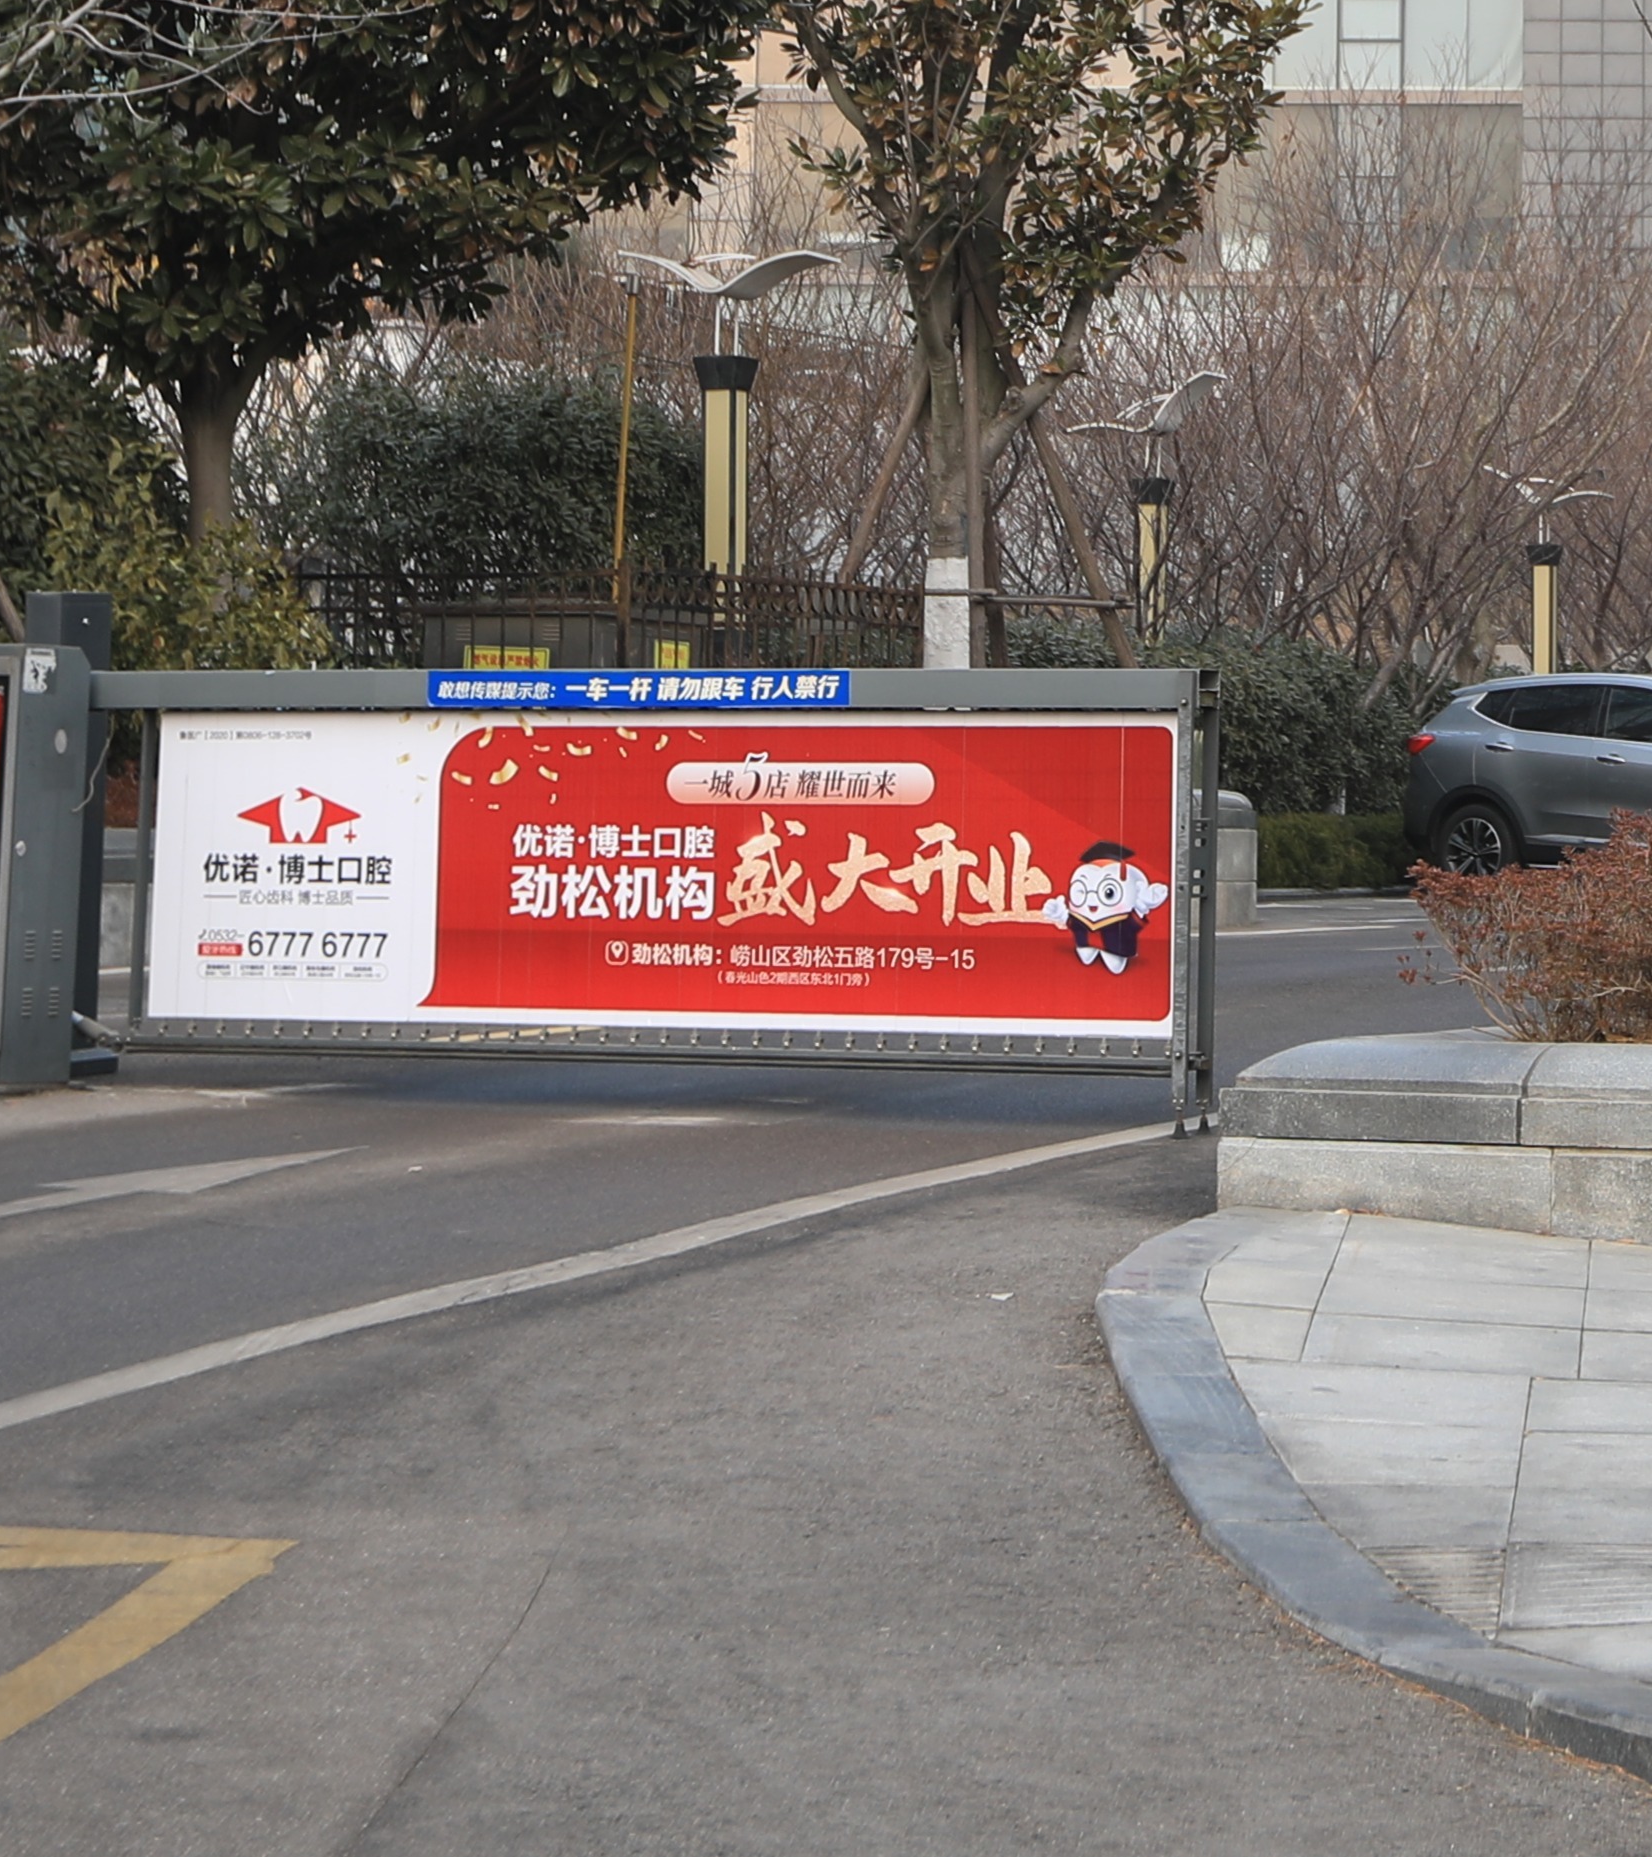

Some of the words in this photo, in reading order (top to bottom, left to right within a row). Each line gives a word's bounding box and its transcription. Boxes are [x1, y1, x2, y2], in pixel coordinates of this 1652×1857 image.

[565, 677, 653, 702] 一车一杆
[657, 677, 746, 701] 请勿跟车
[751, 675, 840, 701] 行人禁行
[684, 752, 791, 801] 一城5店
[795, 770, 897, 799] 耀世而来
[512, 824, 715, 858] 优诺·博士口腔
[203, 853, 393, 885] 优诺·博士口腔
[717, 811, 1066, 926] 盛大开业
[509, 864, 715, 920] 劲松机构
[248, 931, 314, 957] 6777
[321, 932, 388, 958] 6777
